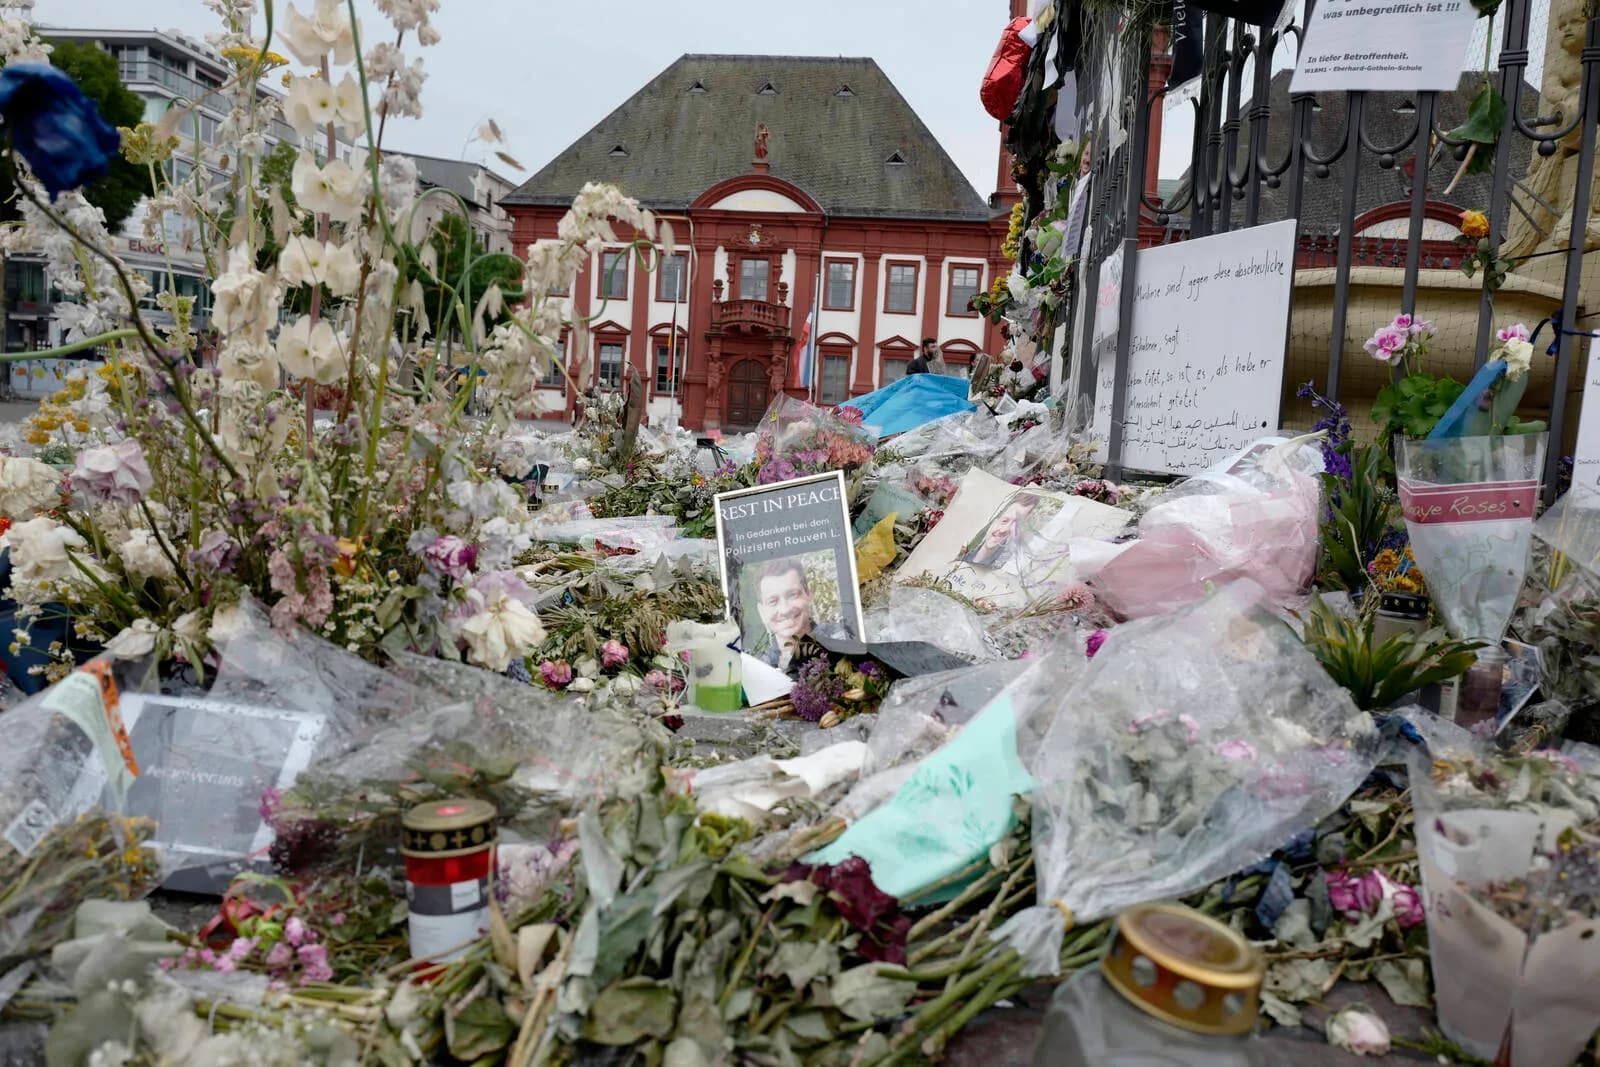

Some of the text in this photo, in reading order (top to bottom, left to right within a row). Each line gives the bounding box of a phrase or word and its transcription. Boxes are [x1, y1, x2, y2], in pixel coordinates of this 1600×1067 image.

[1323, 3, 1460, 19] was unbegreiflich ist !!!
[1319, 54, 1342, 62] tiefer
[1344, 52, 1409, 61] Betroffenheit.
[1187, 275, 1209, 302] gegen
[720, 487, 840, 520] REST IN PEACE
[1449, 496, 1507, 515] Roses
[747, 525, 791, 539] Gedanken
[793, 522, 807, 530] bei
[810, 518, 830, 527] dem
[726, 529, 840, 557] Polizisten Rouven L.
